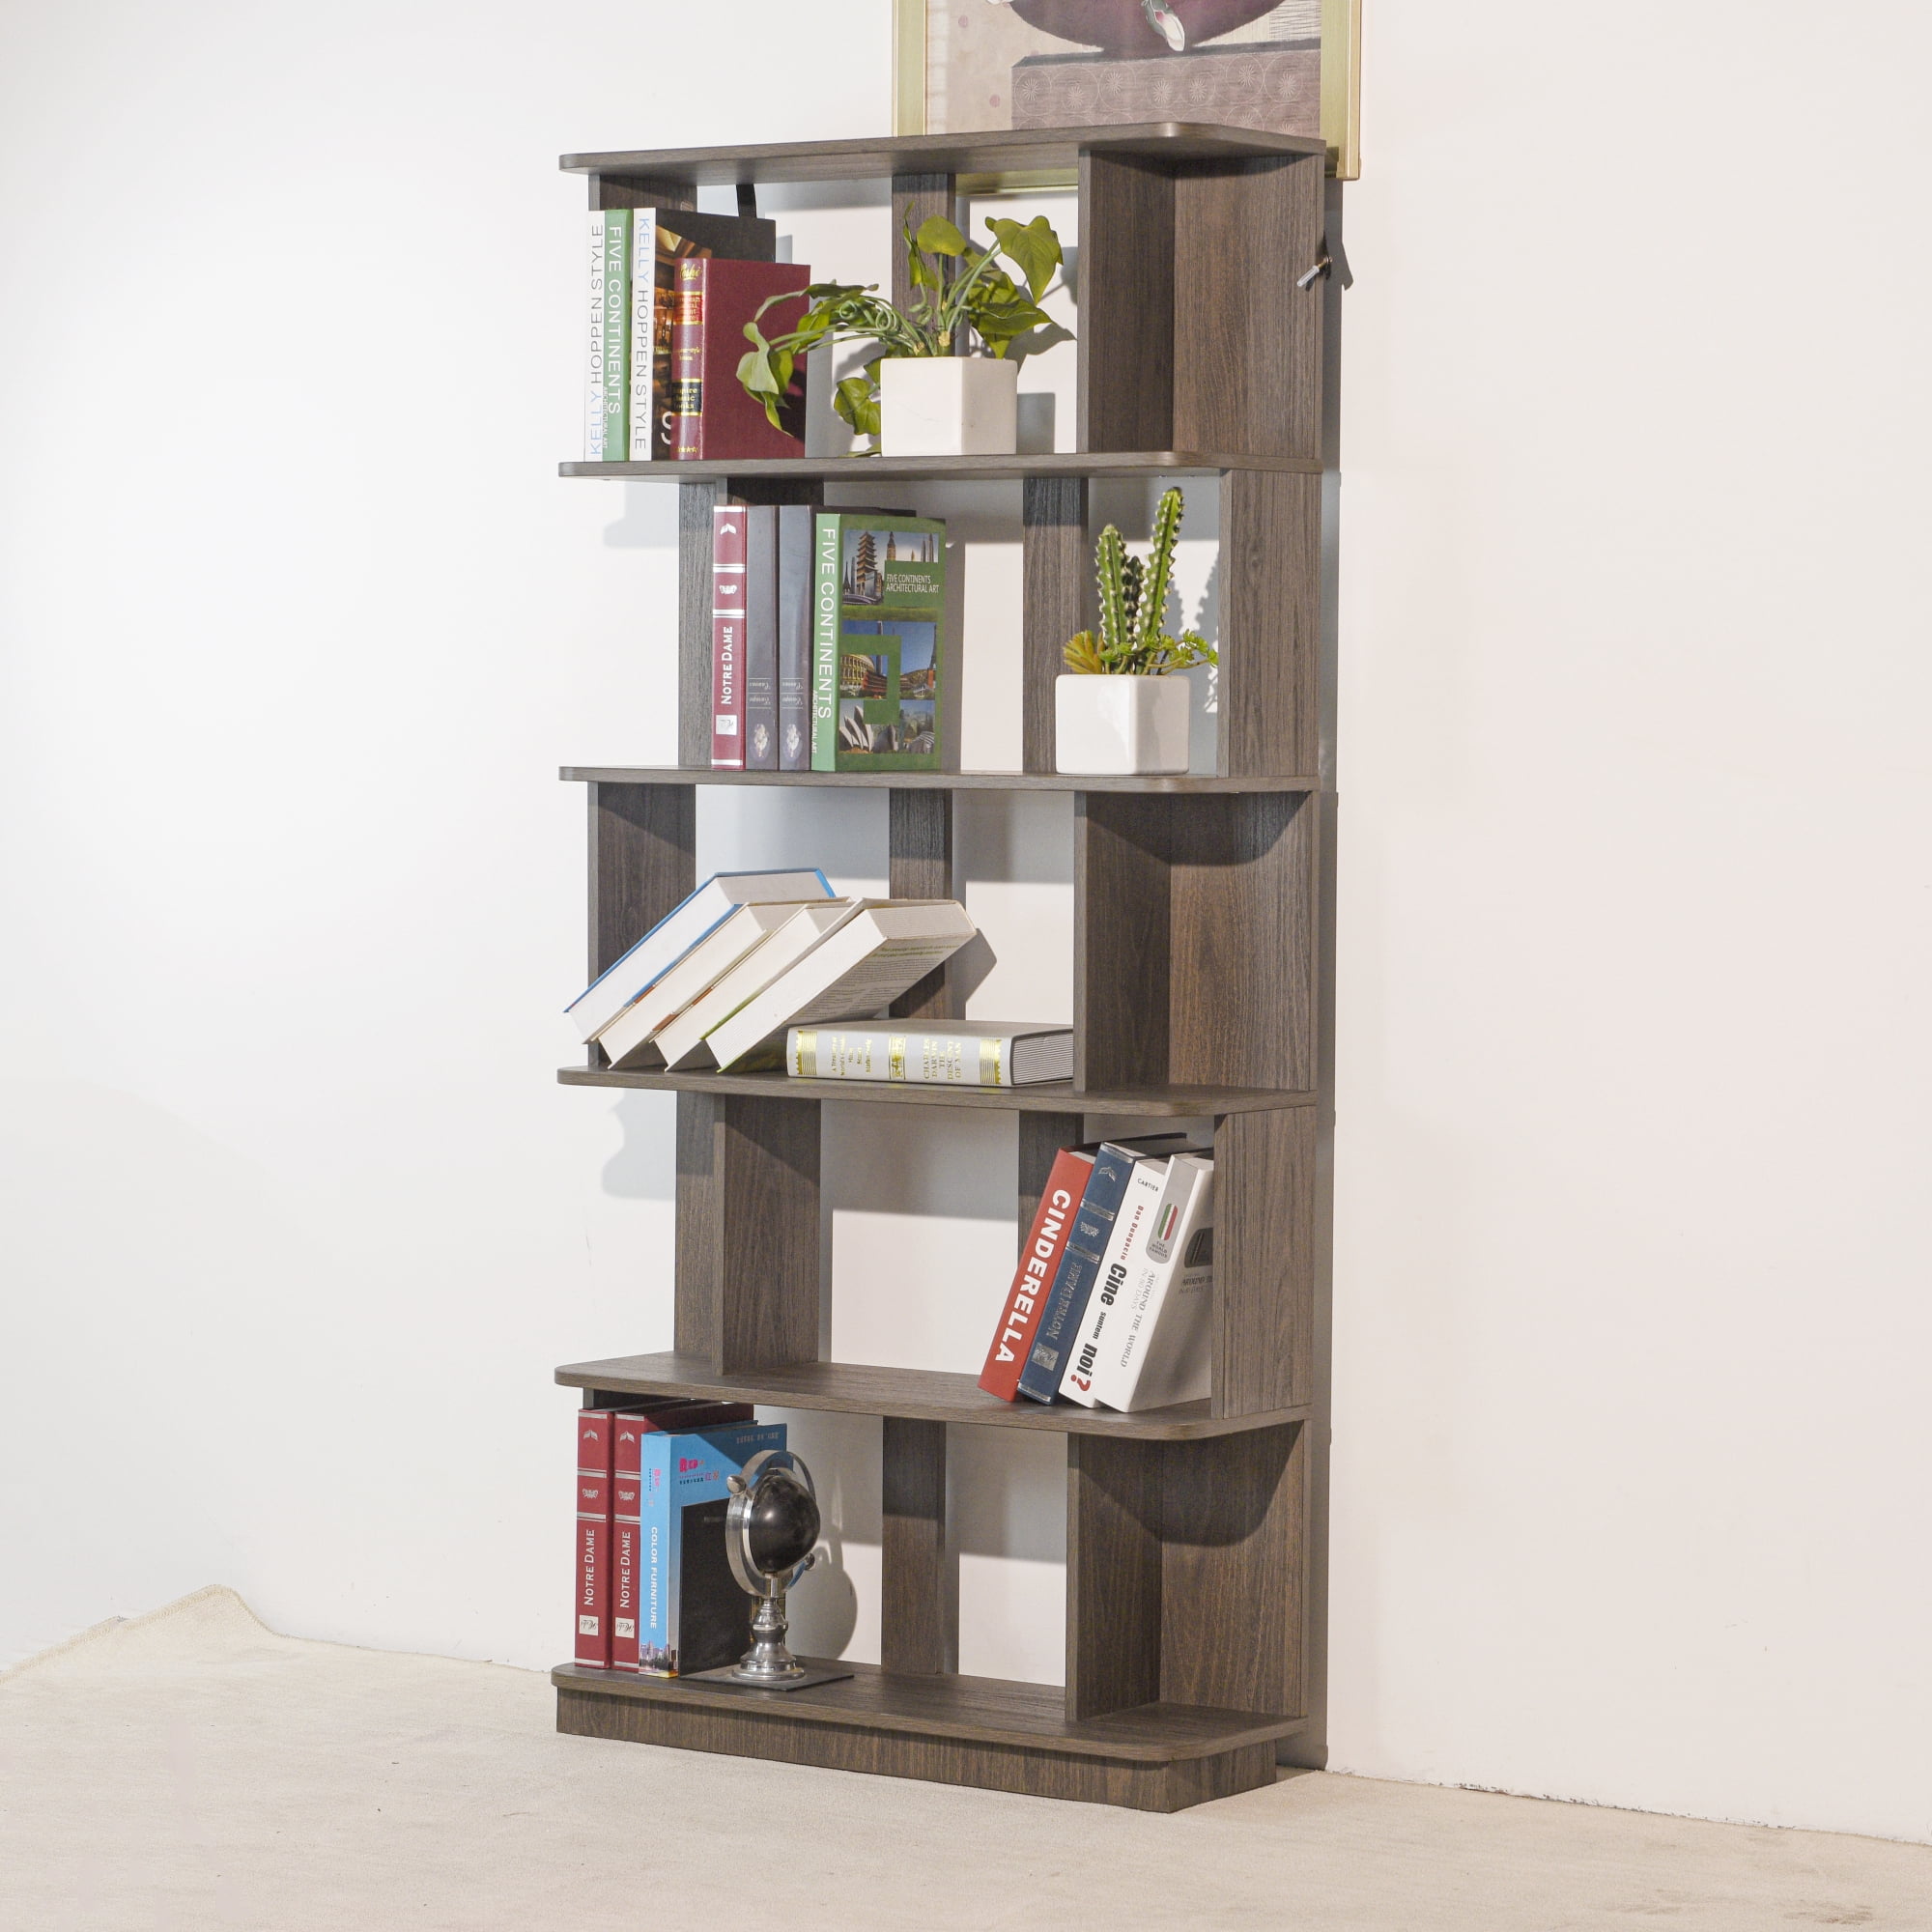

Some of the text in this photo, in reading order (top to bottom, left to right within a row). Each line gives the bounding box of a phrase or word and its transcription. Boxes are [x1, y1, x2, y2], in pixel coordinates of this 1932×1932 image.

[590, 223, 604, 455] KELLY HOPPEN STYLE
[608, 225, 623, 414] FIVE CONTINENTS
[634, 217, 650, 450] KELLY HOPPEN STYLE
[886, 573, 931, 584] FIVE CONTINENTS
[886, 582, 940, 594] ARCHITECTURAL ART
[723, 626, 734, 660] DAME
[817, 528, 836, 720] FIVE CONTINENTS
[721, 664, 733, 705] NOTRE
[1137, 1178, 1159, 1193] CARTIER
[994, 1189, 1072, 1363] CINDERELLA
[1045, 1297, 1071, 1341] NOTRE
[1061, 1262, 1083, 1299] DAME
[1070, 1263, 1127, 1392] Cine suntem noi?
[1121, 1270, 1156, 1368] AROUND THE WORLD
[584, 1529, 595, 1563] DAME
[619, 1531, 631, 1608] NOTRE DAME
[583, 1566, 595, 1606] NOTRE
